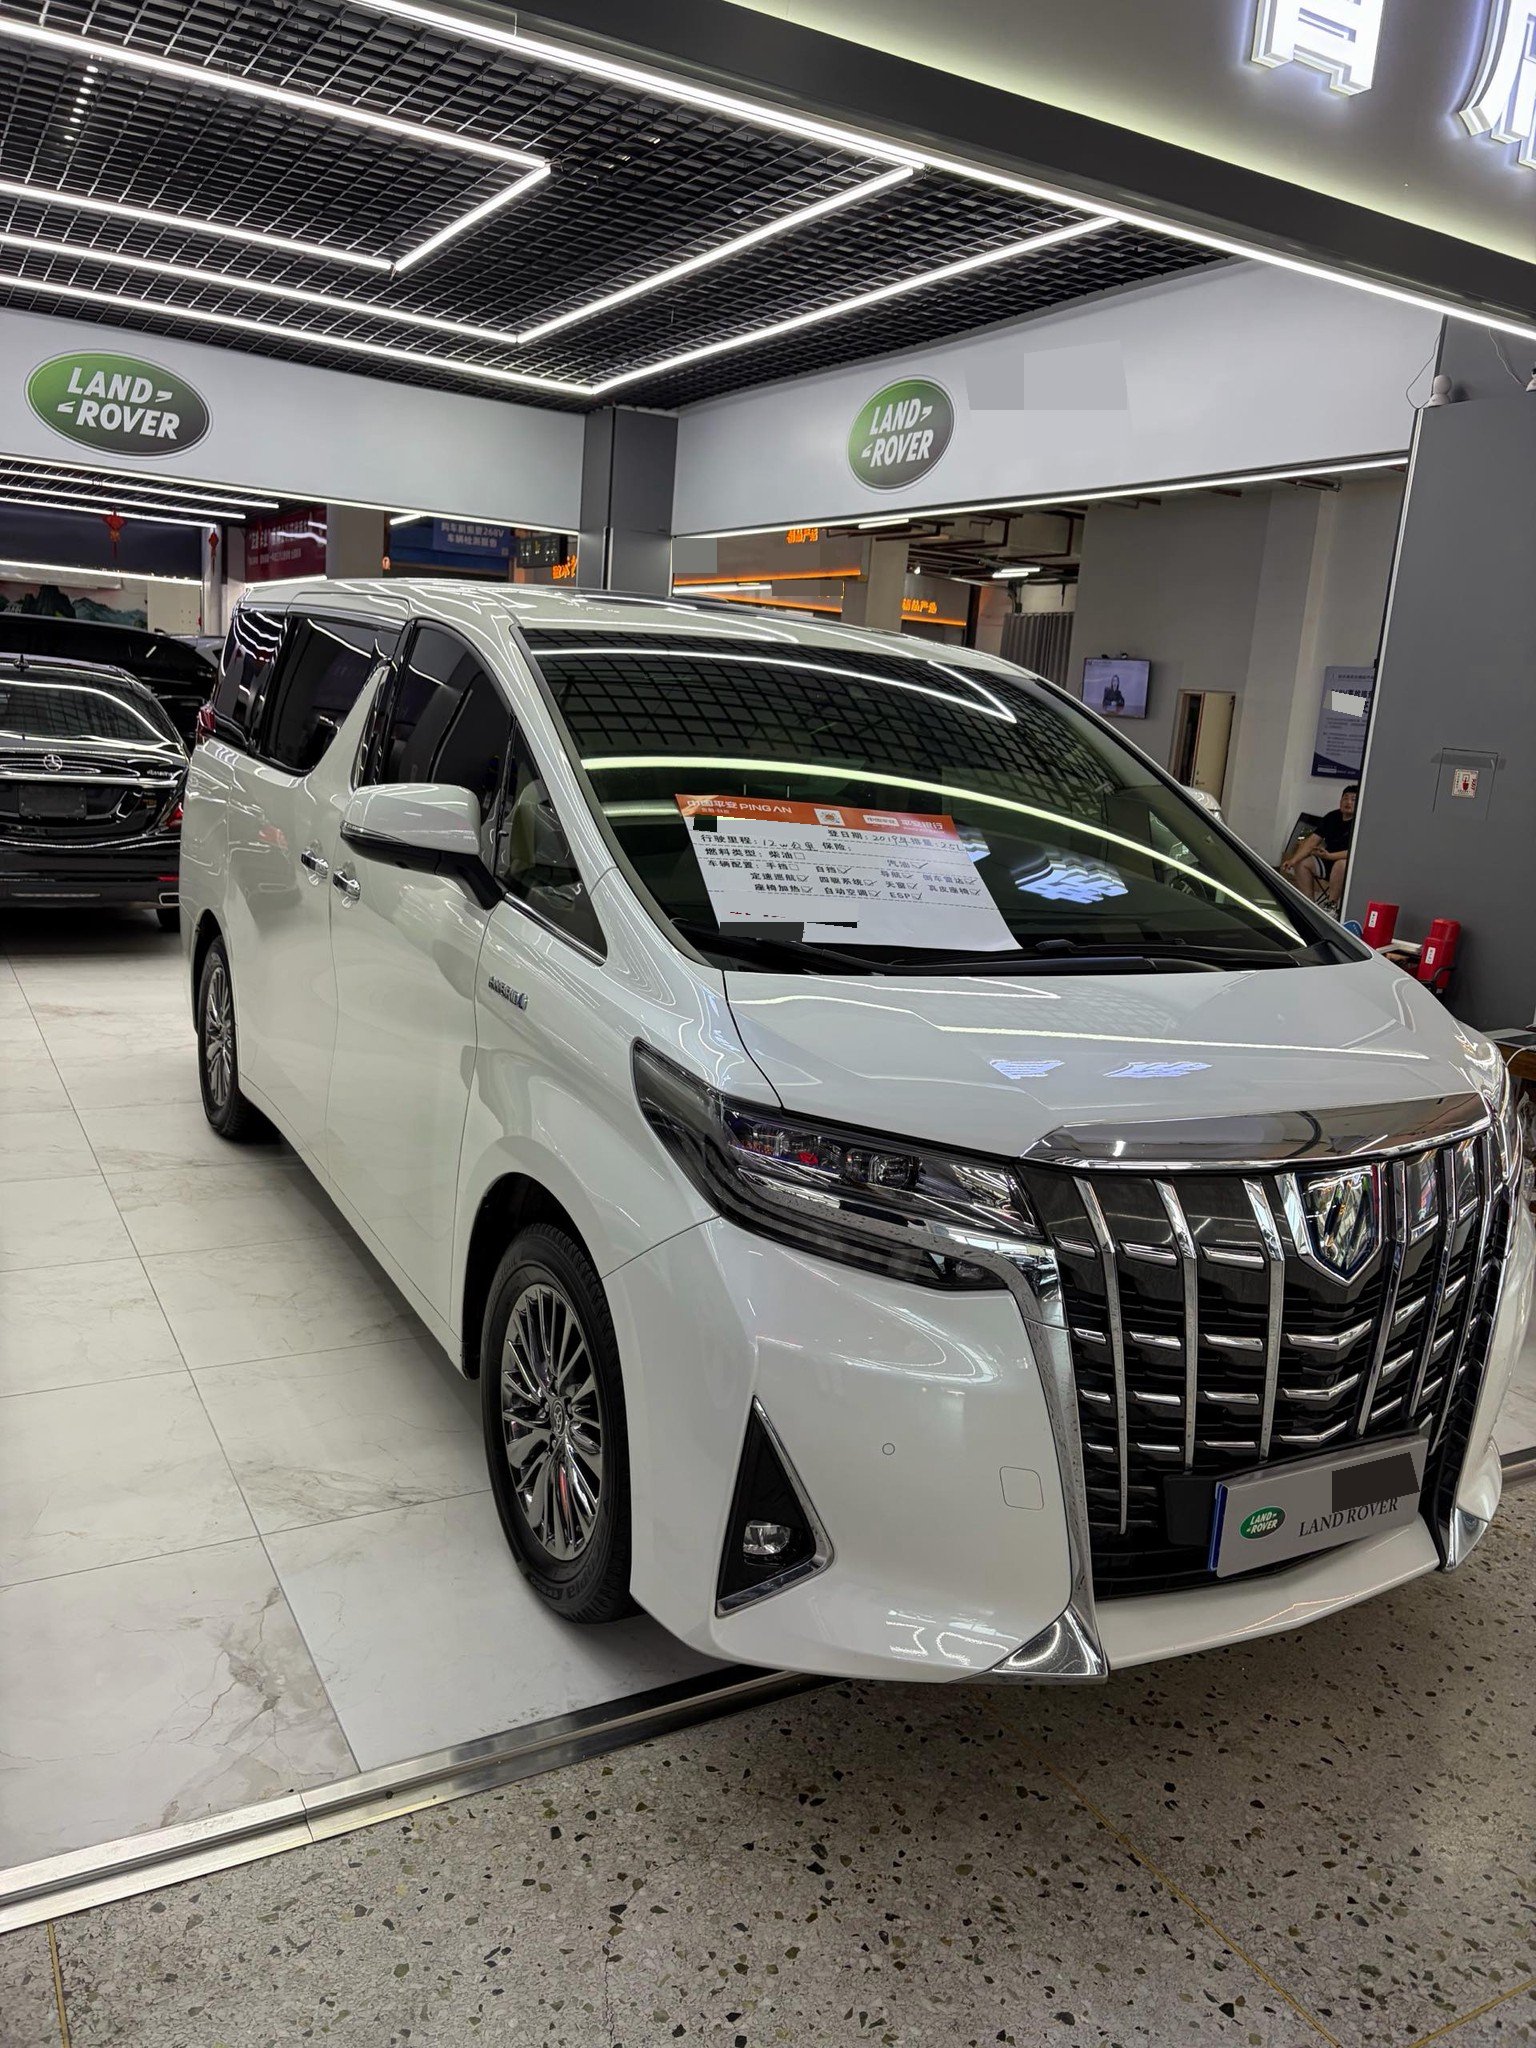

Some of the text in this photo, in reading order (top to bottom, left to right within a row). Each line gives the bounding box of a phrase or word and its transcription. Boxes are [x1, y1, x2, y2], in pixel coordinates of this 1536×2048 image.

[67, 367, 153, 404] LAND
[76, 399, 181, 440] ROVER
[869, 398, 921, 435] LAND
[870, 429, 934, 468] ROVER
[687, 799, 738, 809] 中国平安
[900, 819, 944, 831] 平安银行
[768, 850, 794, 860] 柴油
[750, 872, 797, 882] 定速巡航
[889, 892, 912, 900] ESP
[1250, 1511, 1273, 1526] LAND
[1298, 1496, 1399, 1537] LAND ROVER
[1250, 1519, 1278, 1534] ROVER
